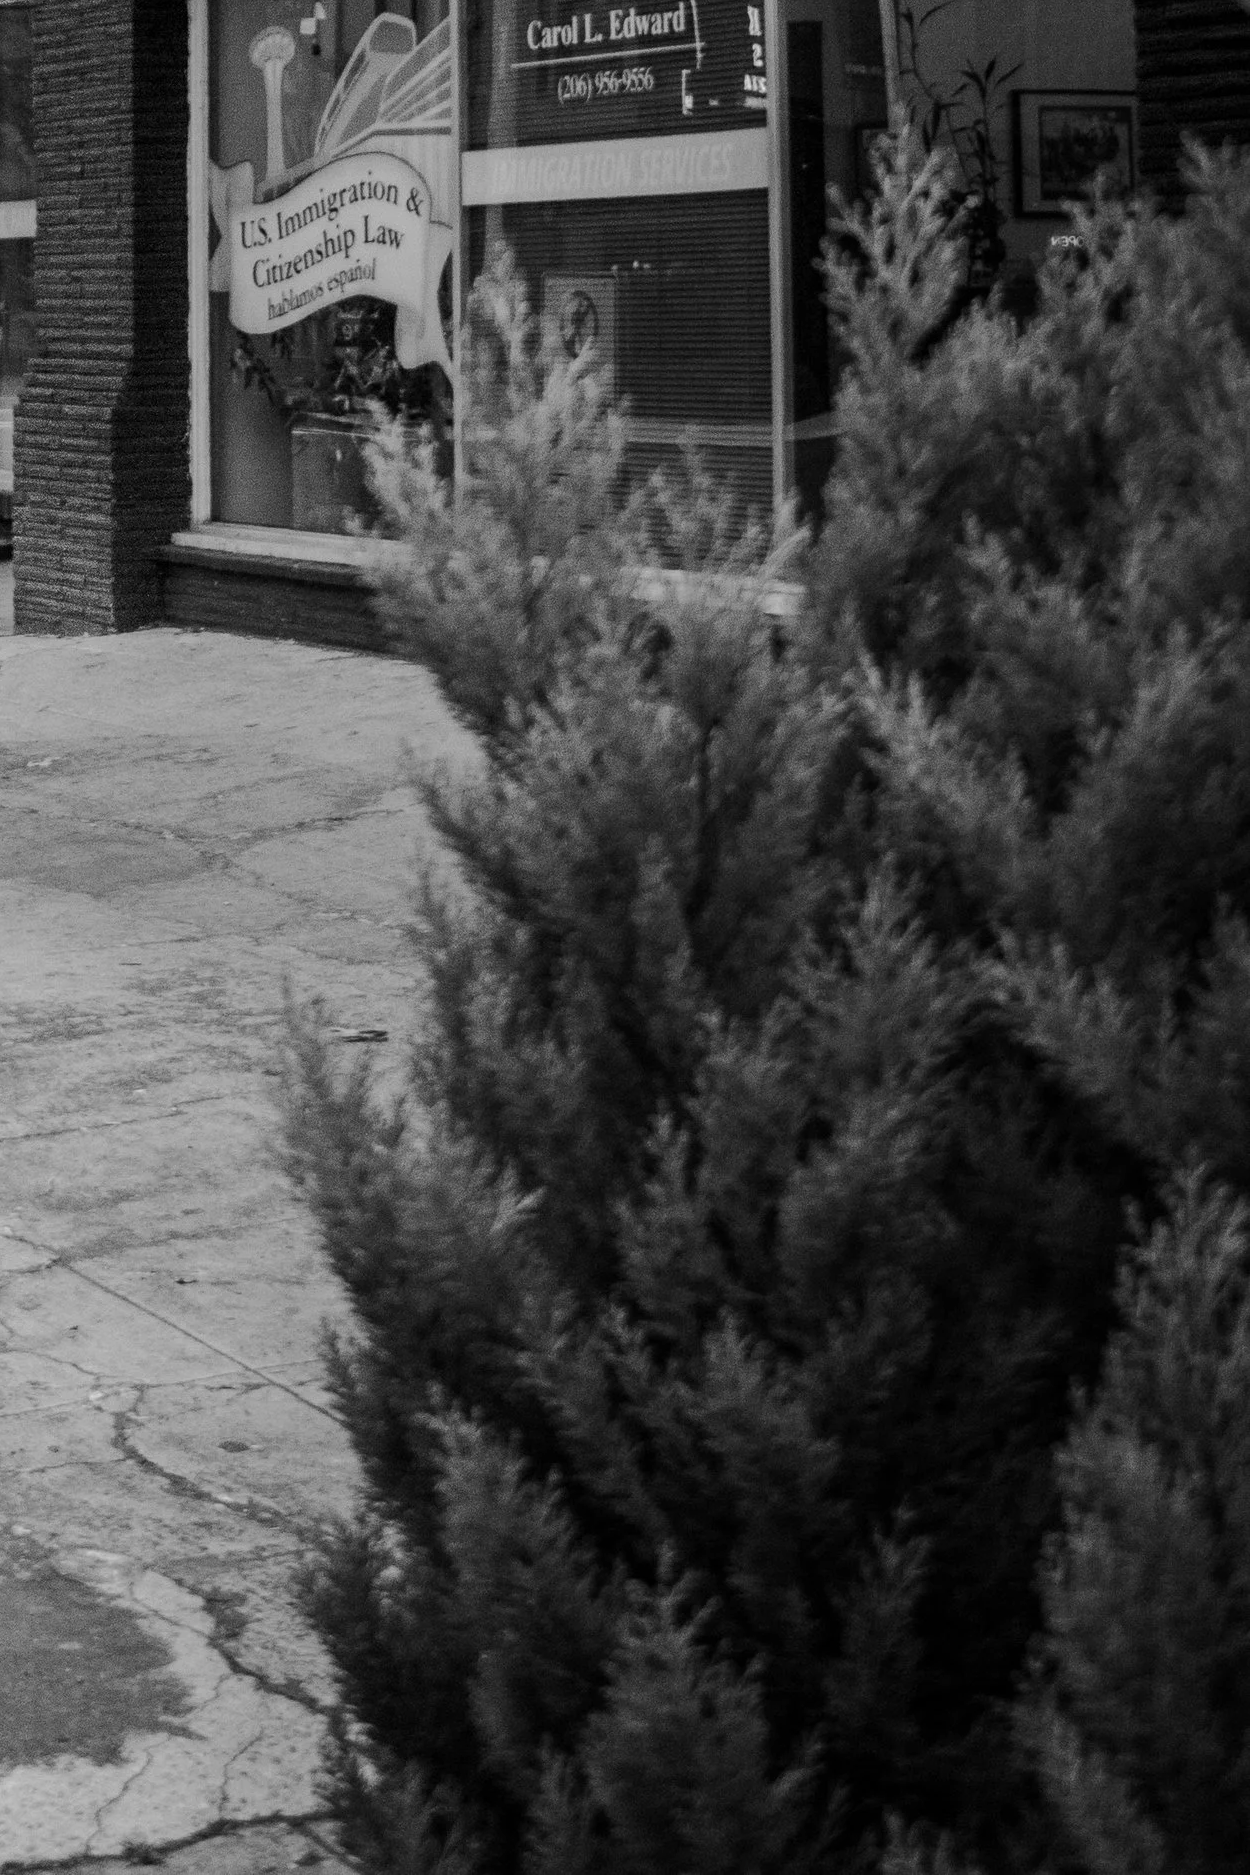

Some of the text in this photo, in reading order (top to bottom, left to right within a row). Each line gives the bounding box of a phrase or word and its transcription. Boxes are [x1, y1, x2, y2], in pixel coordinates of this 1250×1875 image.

[526, 2, 686, 50] Carol L. Edward
[557, 67, 654, 105] (206) 956-9556
[639, 142, 733, 186] SERVICES
[240, 170, 423, 249] U.S. Immigration &
[252, 215, 405, 288] Citizenship Law
[326, 257, 377, 292] español
